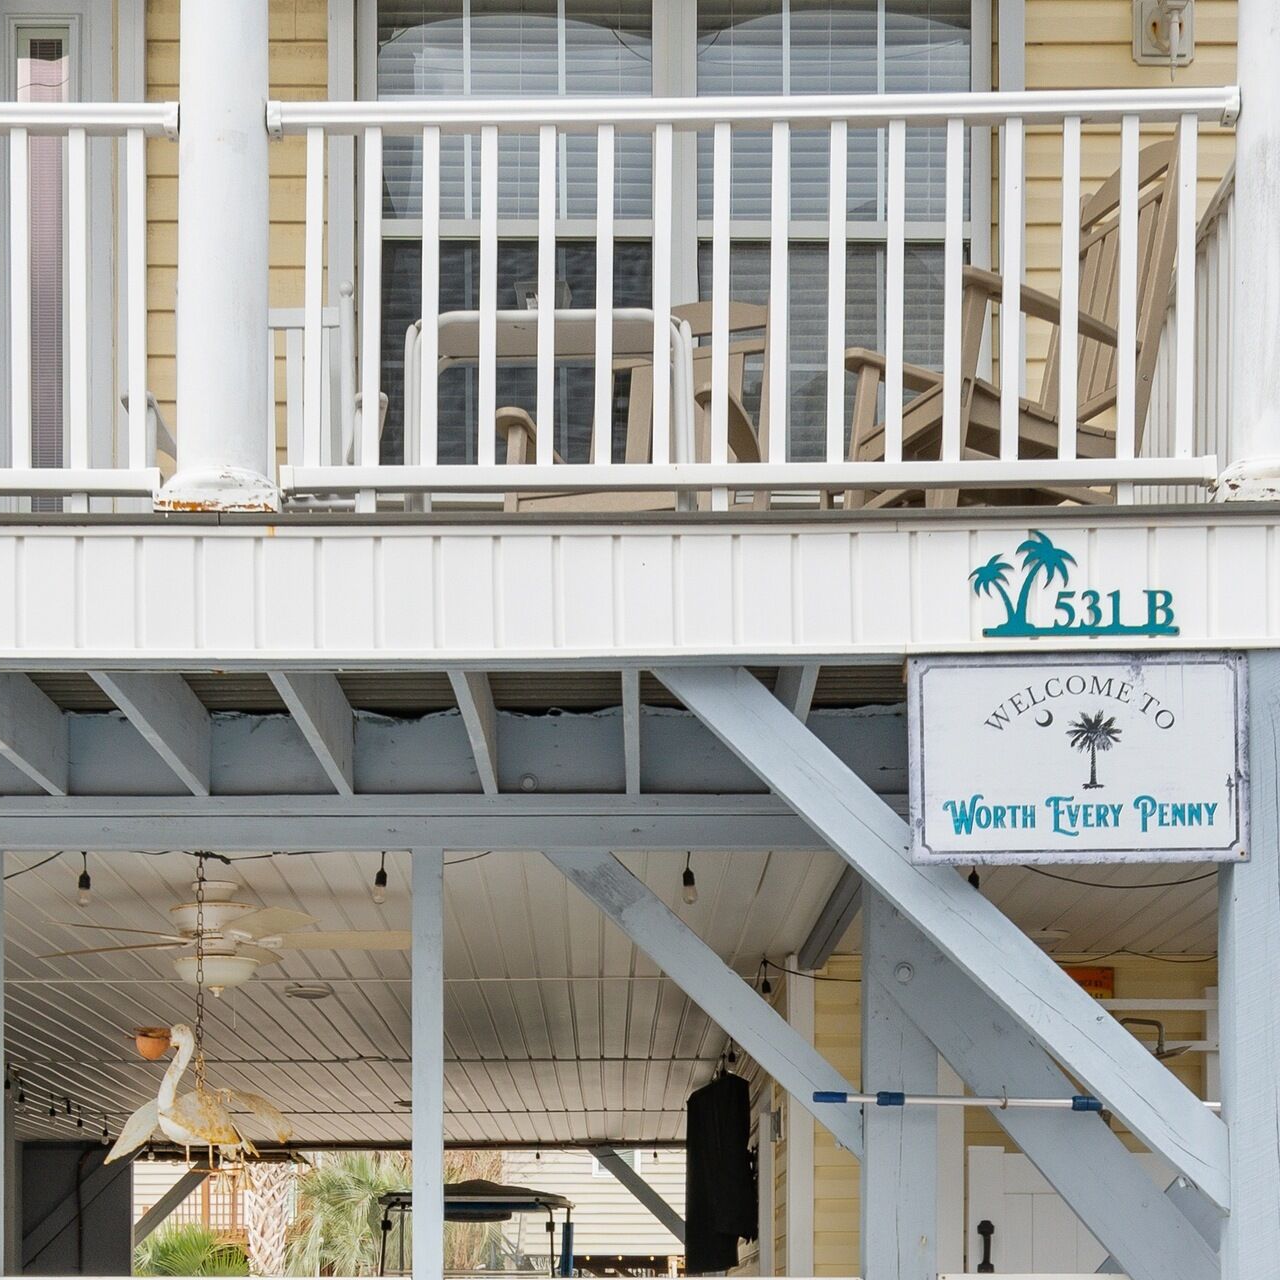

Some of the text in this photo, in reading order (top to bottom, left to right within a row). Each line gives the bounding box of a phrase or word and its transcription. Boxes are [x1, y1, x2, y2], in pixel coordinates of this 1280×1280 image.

[1053, 589, 1175, 628] 531 B
[985, 675, 1175, 733] WELCOME TO
[943, 794, 1218, 837] WORTH EVERY PENNY
